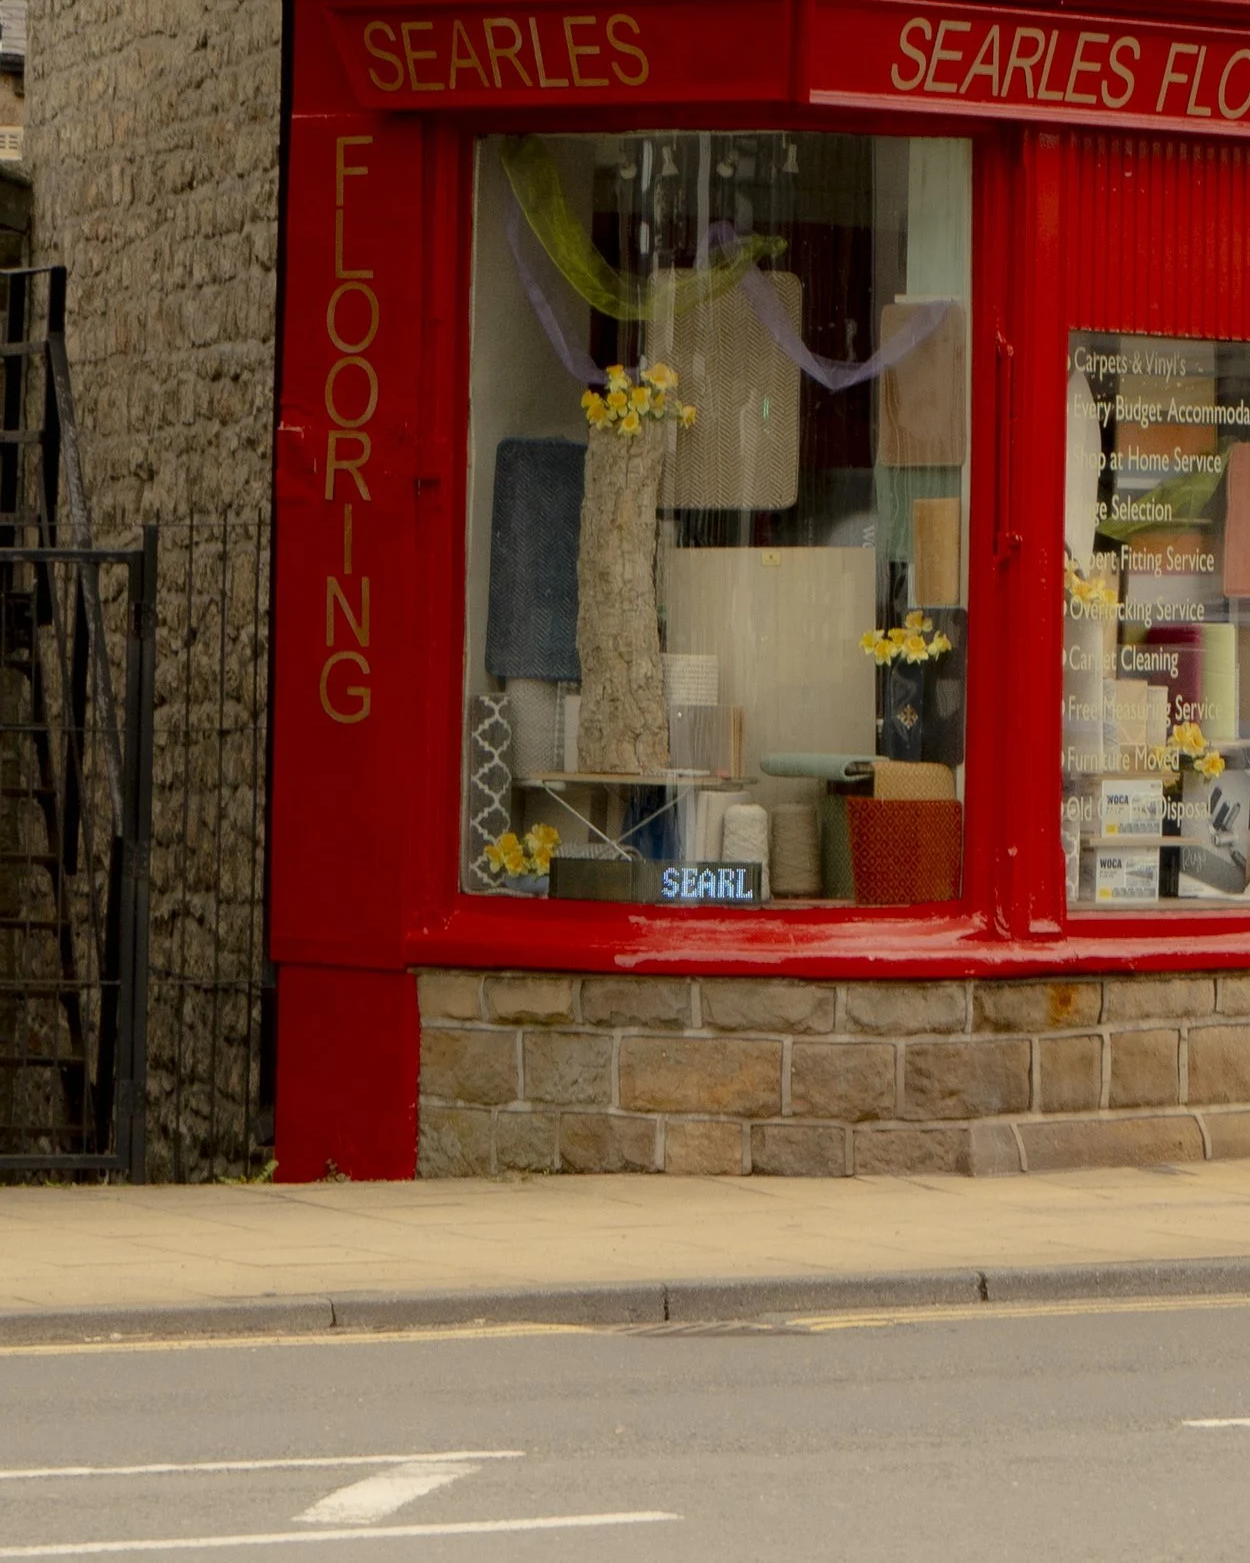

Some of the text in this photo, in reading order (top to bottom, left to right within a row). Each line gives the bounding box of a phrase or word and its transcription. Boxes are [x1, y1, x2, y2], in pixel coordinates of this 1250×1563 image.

[363, 13, 650, 92] SEARLES
[891, 17, 1141, 109] SEARLES
[1074, 346, 1187, 383] Carpets & Vinyl's
[1074, 393, 1111, 428] Every
[1116, 395, 1162, 428] Budget
[318, 136, 380, 724] FLOORING
[1110, 452, 1123, 471] at
[1129, 445, 1169, 473] Home
[1174, 447, 1222, 473] Service
[1112, 494, 1172, 522] Selection
[1121, 544, 1163, 577] Fitting
[1167, 545, 1214, 571] Service
[1070, 596, 1205, 628] Overlocking Service
[1121, 644, 1179, 678] Cleaning
[1068, 695, 1222, 727] Free Measuring Service
[1135, 747, 1180, 771] Moved
[1067, 795, 1093, 822] Old
[1156, 794, 1211, 829] Disposal
[1099, 858, 1122, 869] WOCA
[662, 867, 753, 899] SEARL
